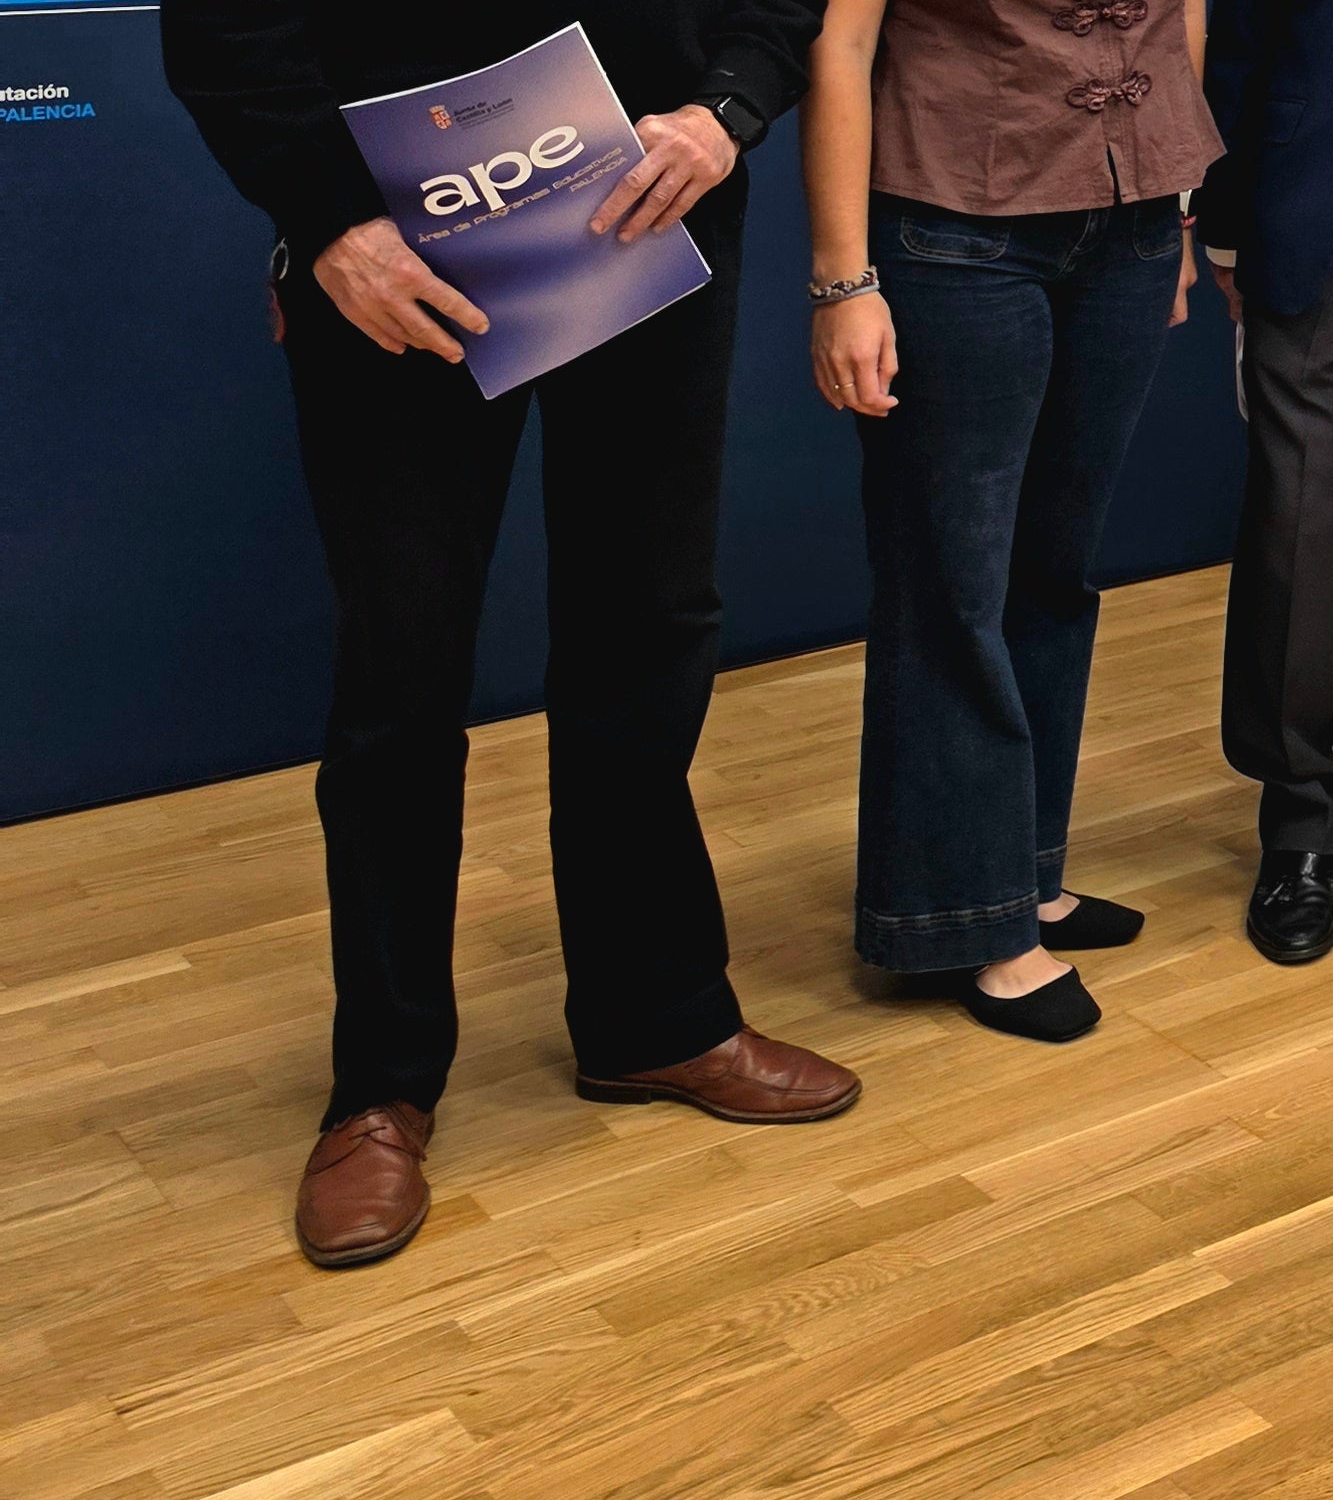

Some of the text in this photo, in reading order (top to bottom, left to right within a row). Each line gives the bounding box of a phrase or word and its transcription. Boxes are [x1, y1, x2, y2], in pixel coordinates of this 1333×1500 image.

[420, 125, 585, 215] ape
[569, 156, 628, 192] PALENCIA
[453, 222, 471, 232] de
